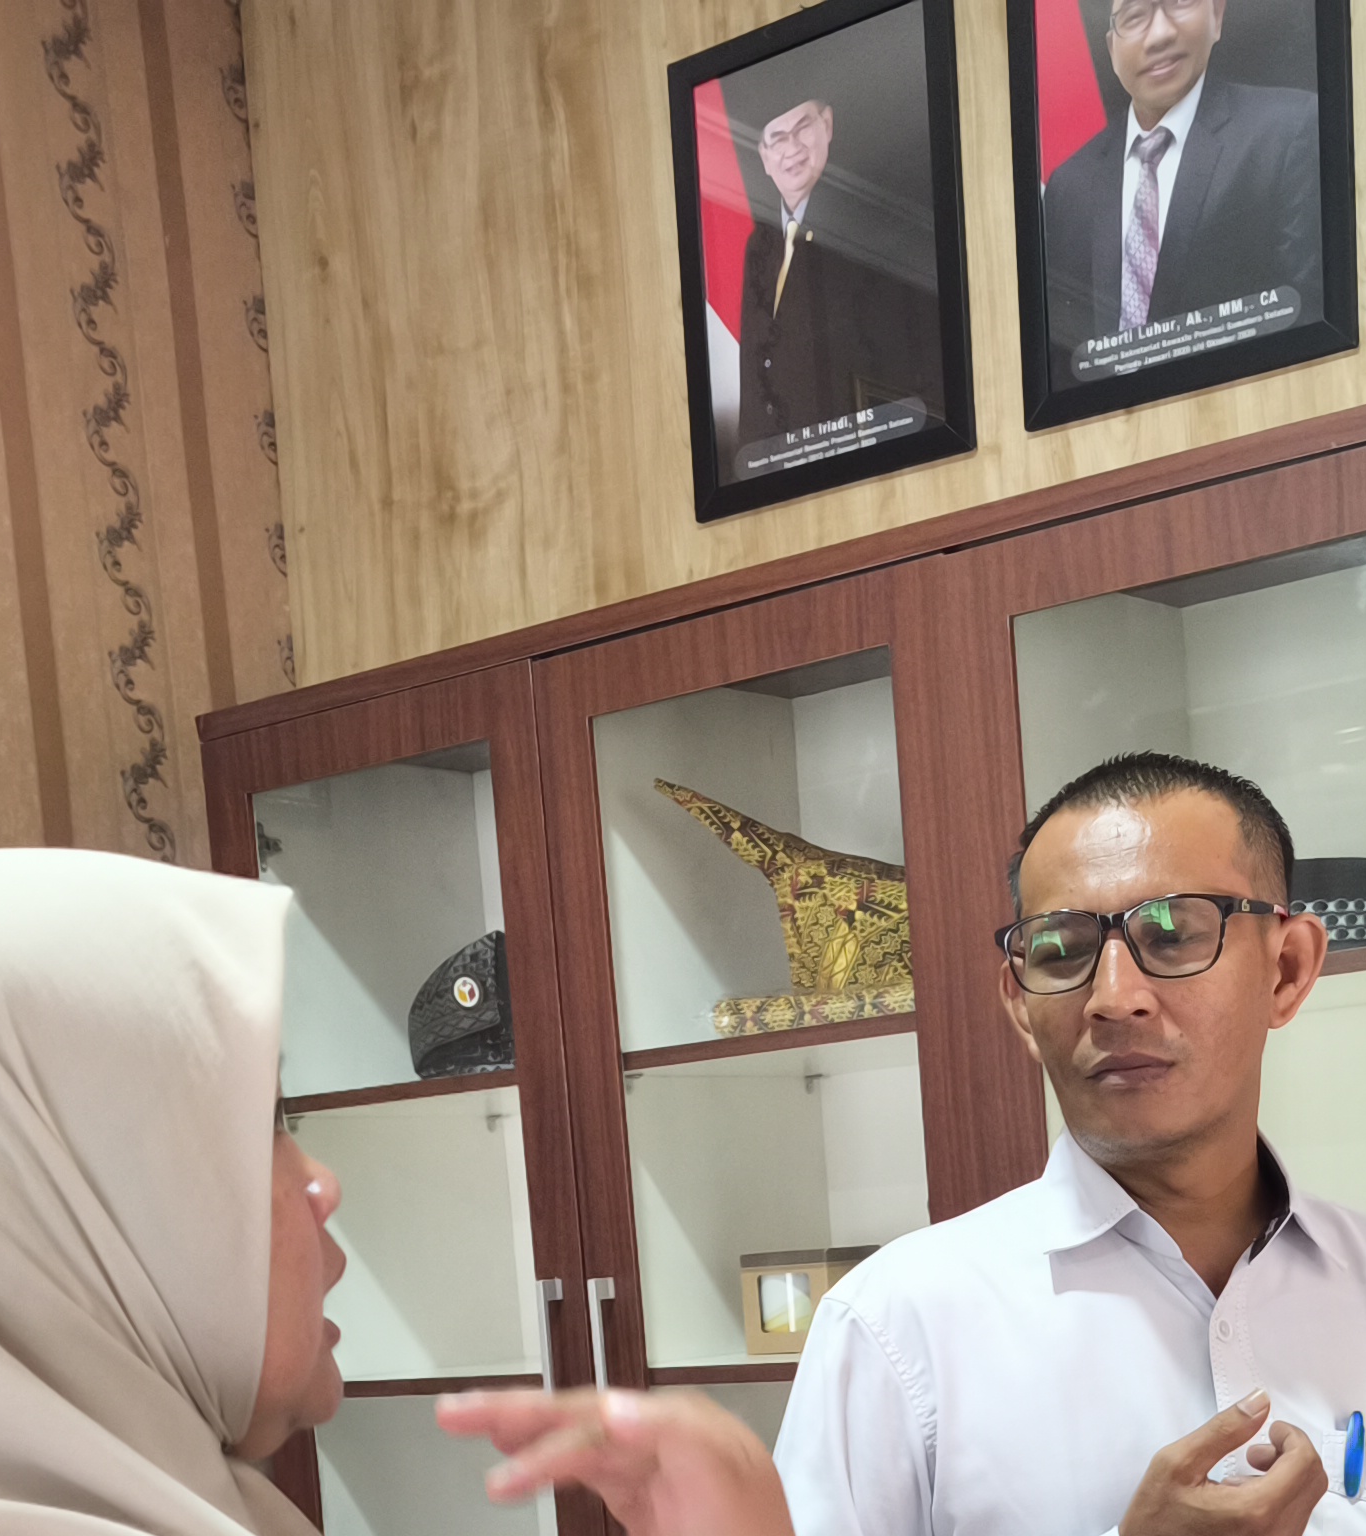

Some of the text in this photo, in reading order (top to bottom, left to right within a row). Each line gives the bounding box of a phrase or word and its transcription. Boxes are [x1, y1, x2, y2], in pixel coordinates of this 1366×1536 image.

[1138, 320, 1180, 339] Luhur,
[1260, 289, 1279, 306] CA
[786, 432, 799, 444] Ir.
[802, 426, 815, 440] H.
[856, 408, 874, 424] MS
